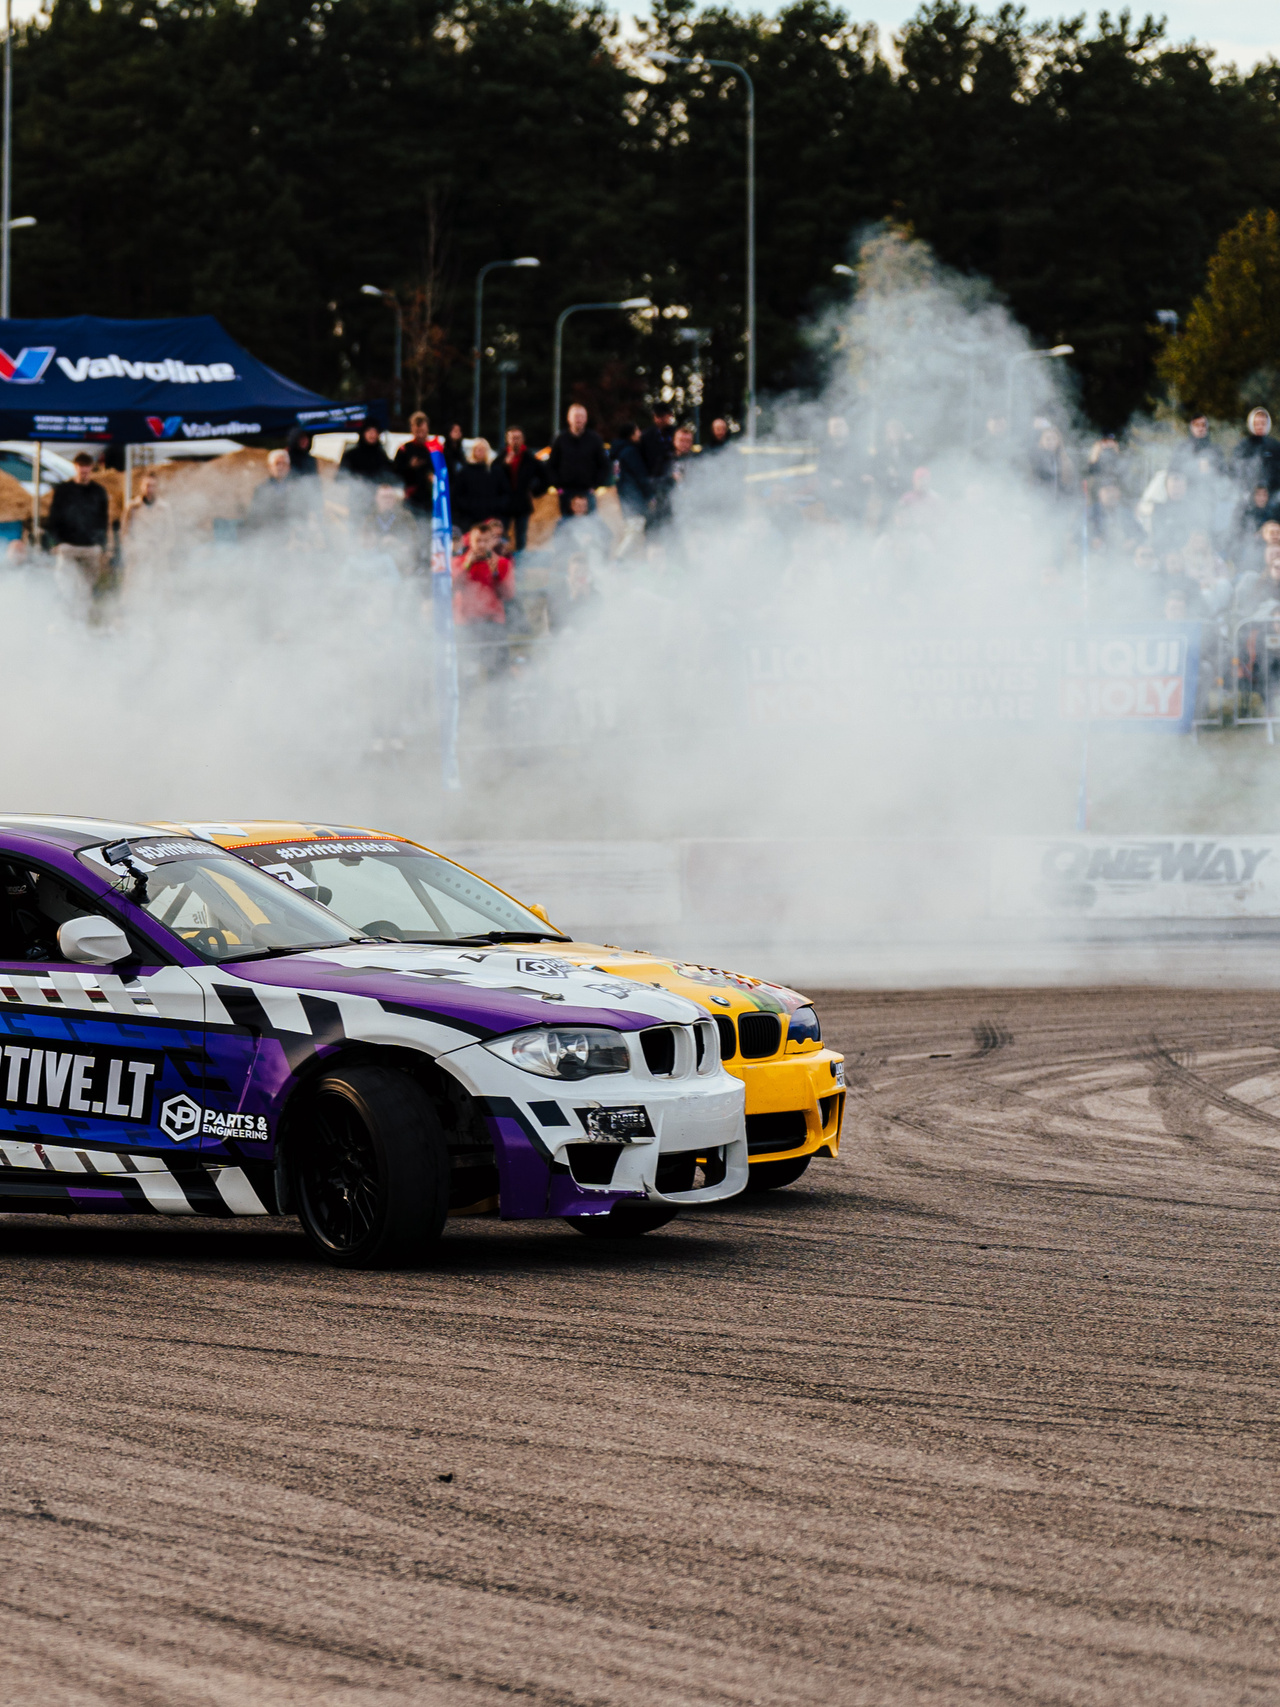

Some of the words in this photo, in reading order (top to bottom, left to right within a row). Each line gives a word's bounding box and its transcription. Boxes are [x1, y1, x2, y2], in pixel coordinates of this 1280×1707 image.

[56, 354, 236, 384] Valvoline
[1064, 639, 1180, 676] LIQUI
[202, 1123, 268, 1141] ENGINEERING
[203, 1109, 255, 1129] PARTS
[257, 1116, 268, 1131] &
